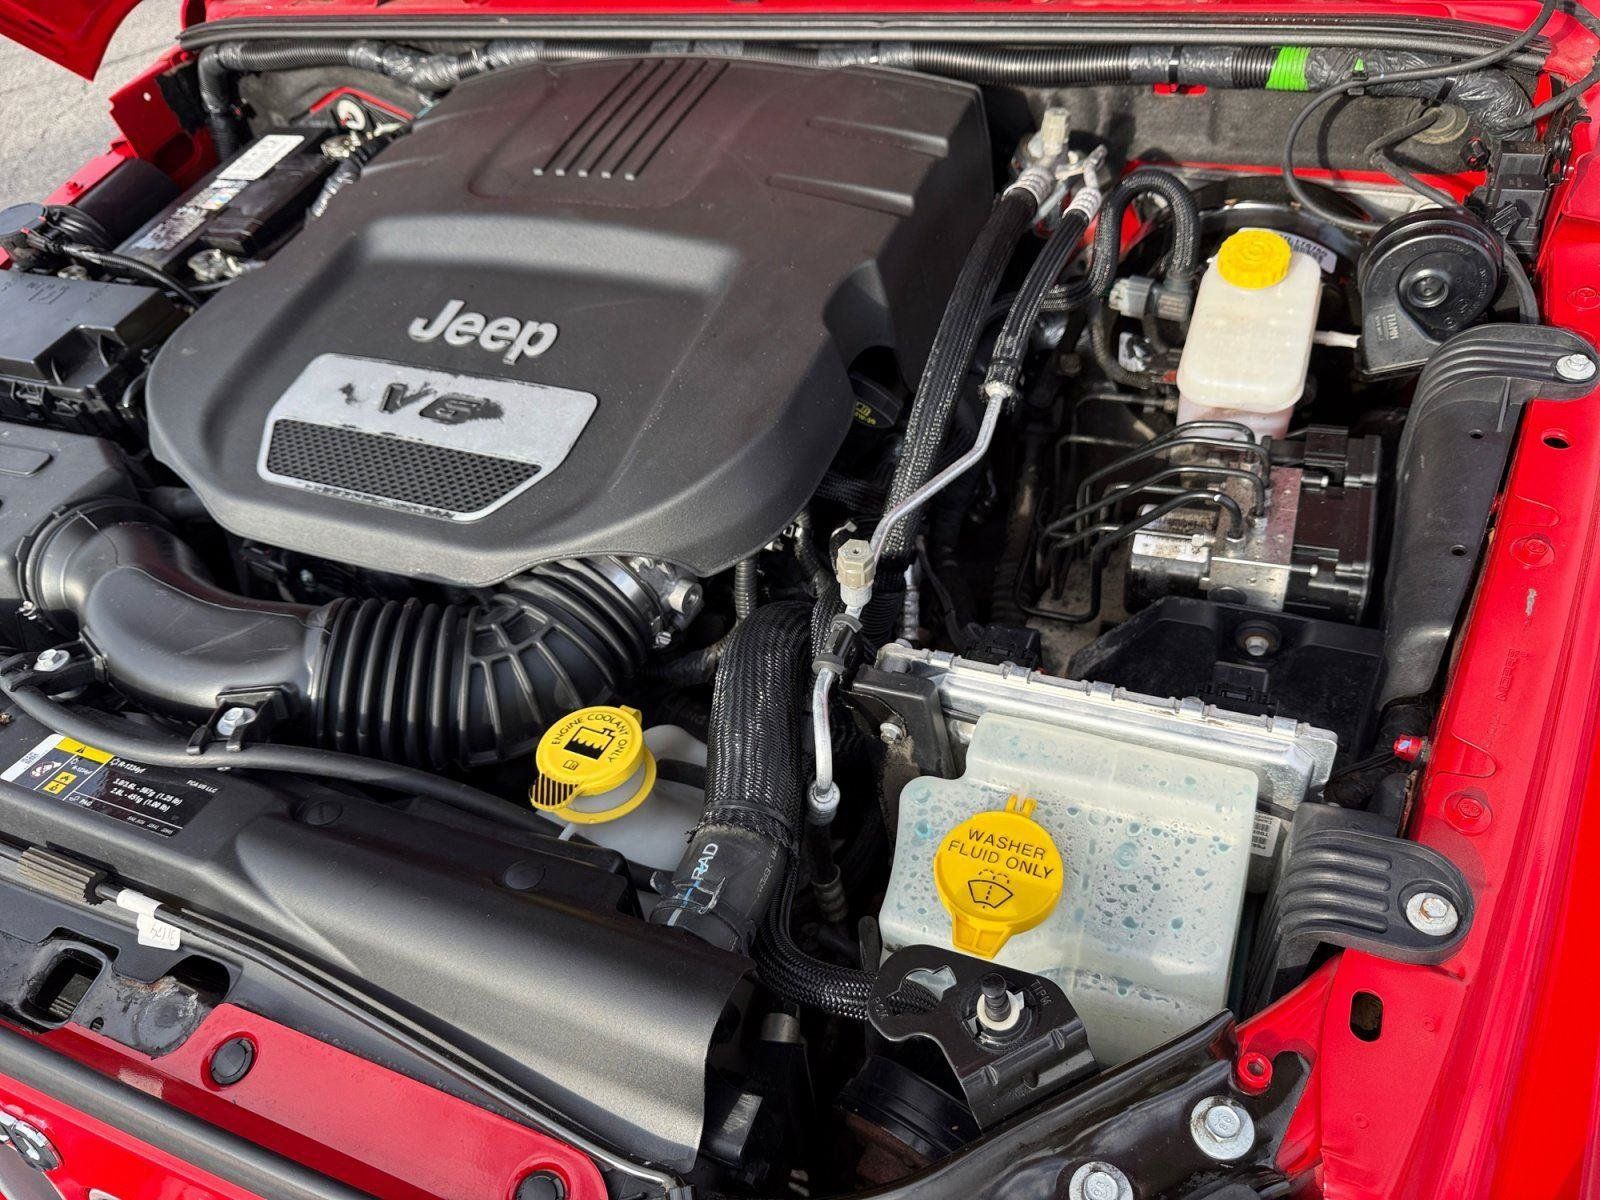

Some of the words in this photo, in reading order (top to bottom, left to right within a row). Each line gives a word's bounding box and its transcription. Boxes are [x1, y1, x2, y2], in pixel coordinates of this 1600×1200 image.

[408, 299, 559, 366] Jeep
[378, 382, 490, 426] V6
[551, 717, 584, 745] ENGINE
[587, 713, 630, 736] COOLANT
[117, 760, 147, 774] R-1234yf
[607, 738, 628, 763] ONLY
[947, 839, 1000, 864] FLUID
[1005, 856, 1054, 880] ONLY
[968, 828, 1046, 861] WASHER
[690, 842, 719, 882] RAD
